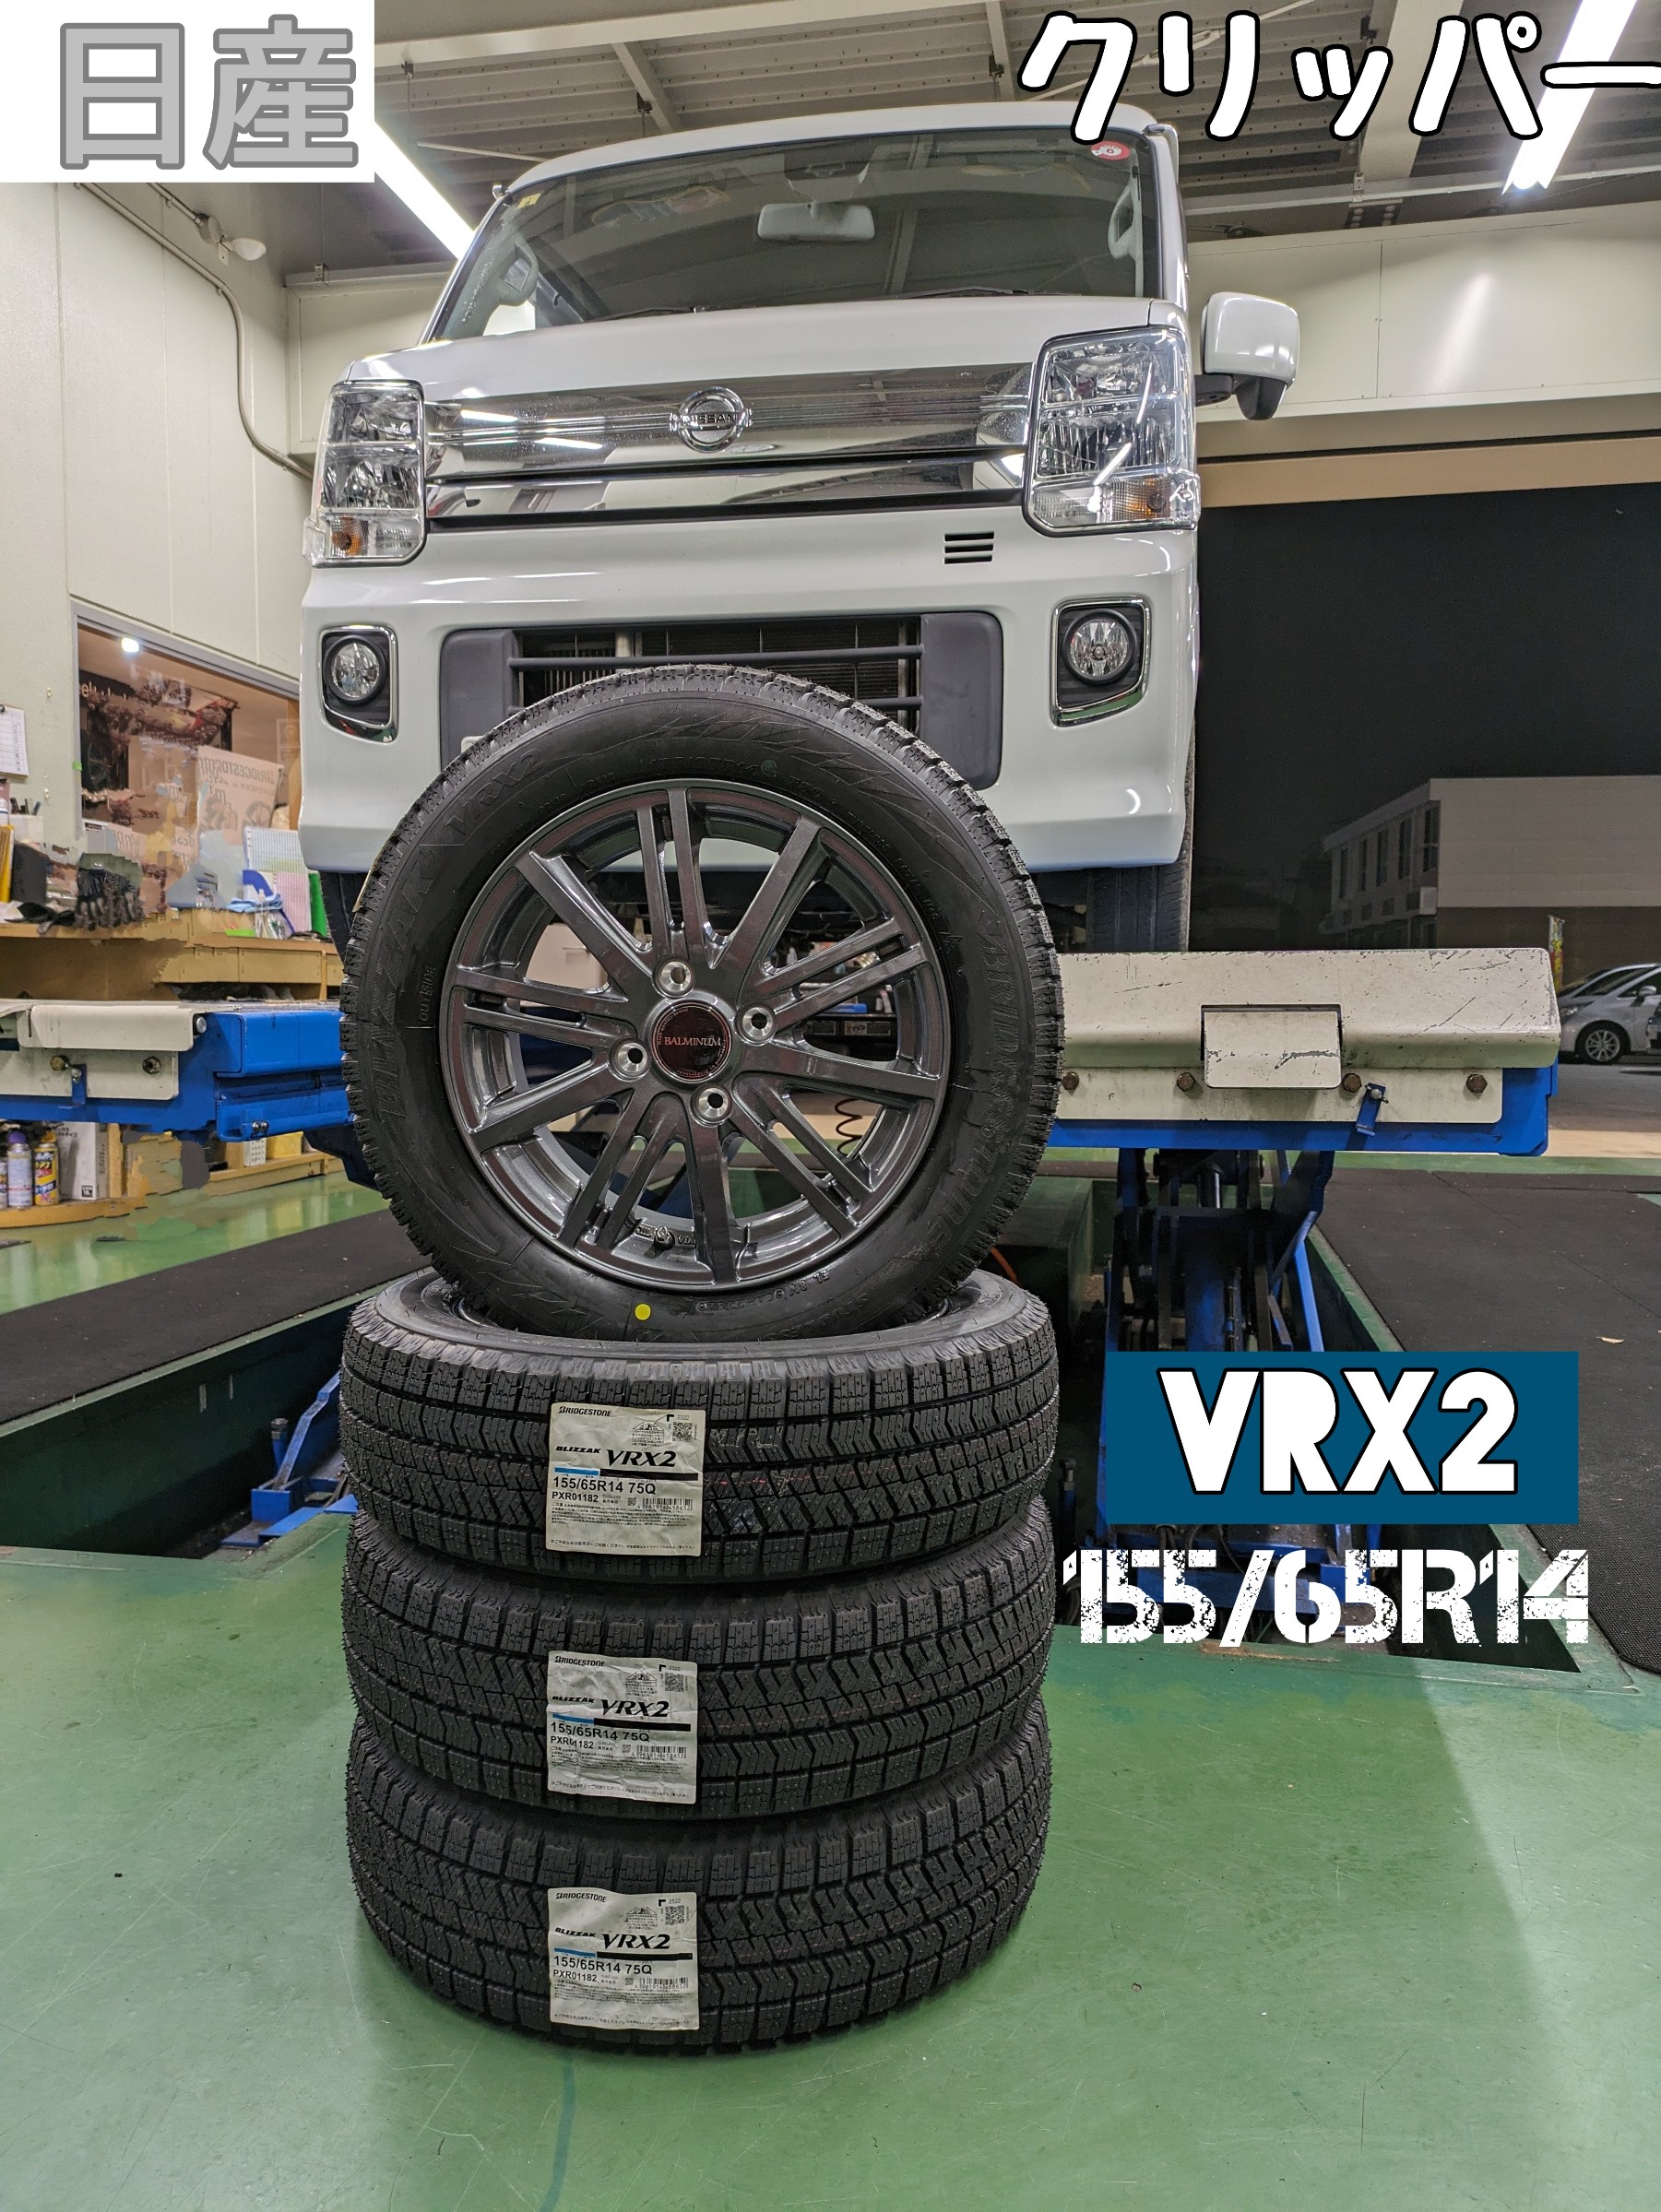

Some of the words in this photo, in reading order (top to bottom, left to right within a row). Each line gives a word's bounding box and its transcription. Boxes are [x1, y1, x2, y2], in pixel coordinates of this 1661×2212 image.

[682, 414, 736, 425] SSAN
[664, 1036, 721, 1047] BALMINUM
[558, 1405, 611, 1417] BRIDGESTONE
[555, 1446, 601, 1454] BLIZZAK
[606, 1449, 677, 1467] VRX2
[553, 1476, 623, 1493] 155/65R14
[628, 1483, 656, 1495] 75Q
[552, 1491, 599, 1503] PXR01182
[554, 1655, 606, 1667] BRIDGESTONE
[552, 1696, 595, 1704] BLIZZAK
[600, 1699, 670, 1717] VRX2
[551, 1722, 618, 1740] 155/65R14
[623, 1732, 650, 1742] 75Q
[555, 1892, 607, 1903] BRIDGESTONE
[554, 1927, 597, 1937] BLIZZAK
[601, 1934, 670, 1949] VRX2
[554, 1956, 622, 1973] 155/65R14
[625, 1964, 652, 1975] 75Q
[553, 1970, 598, 1981] PXR01182
